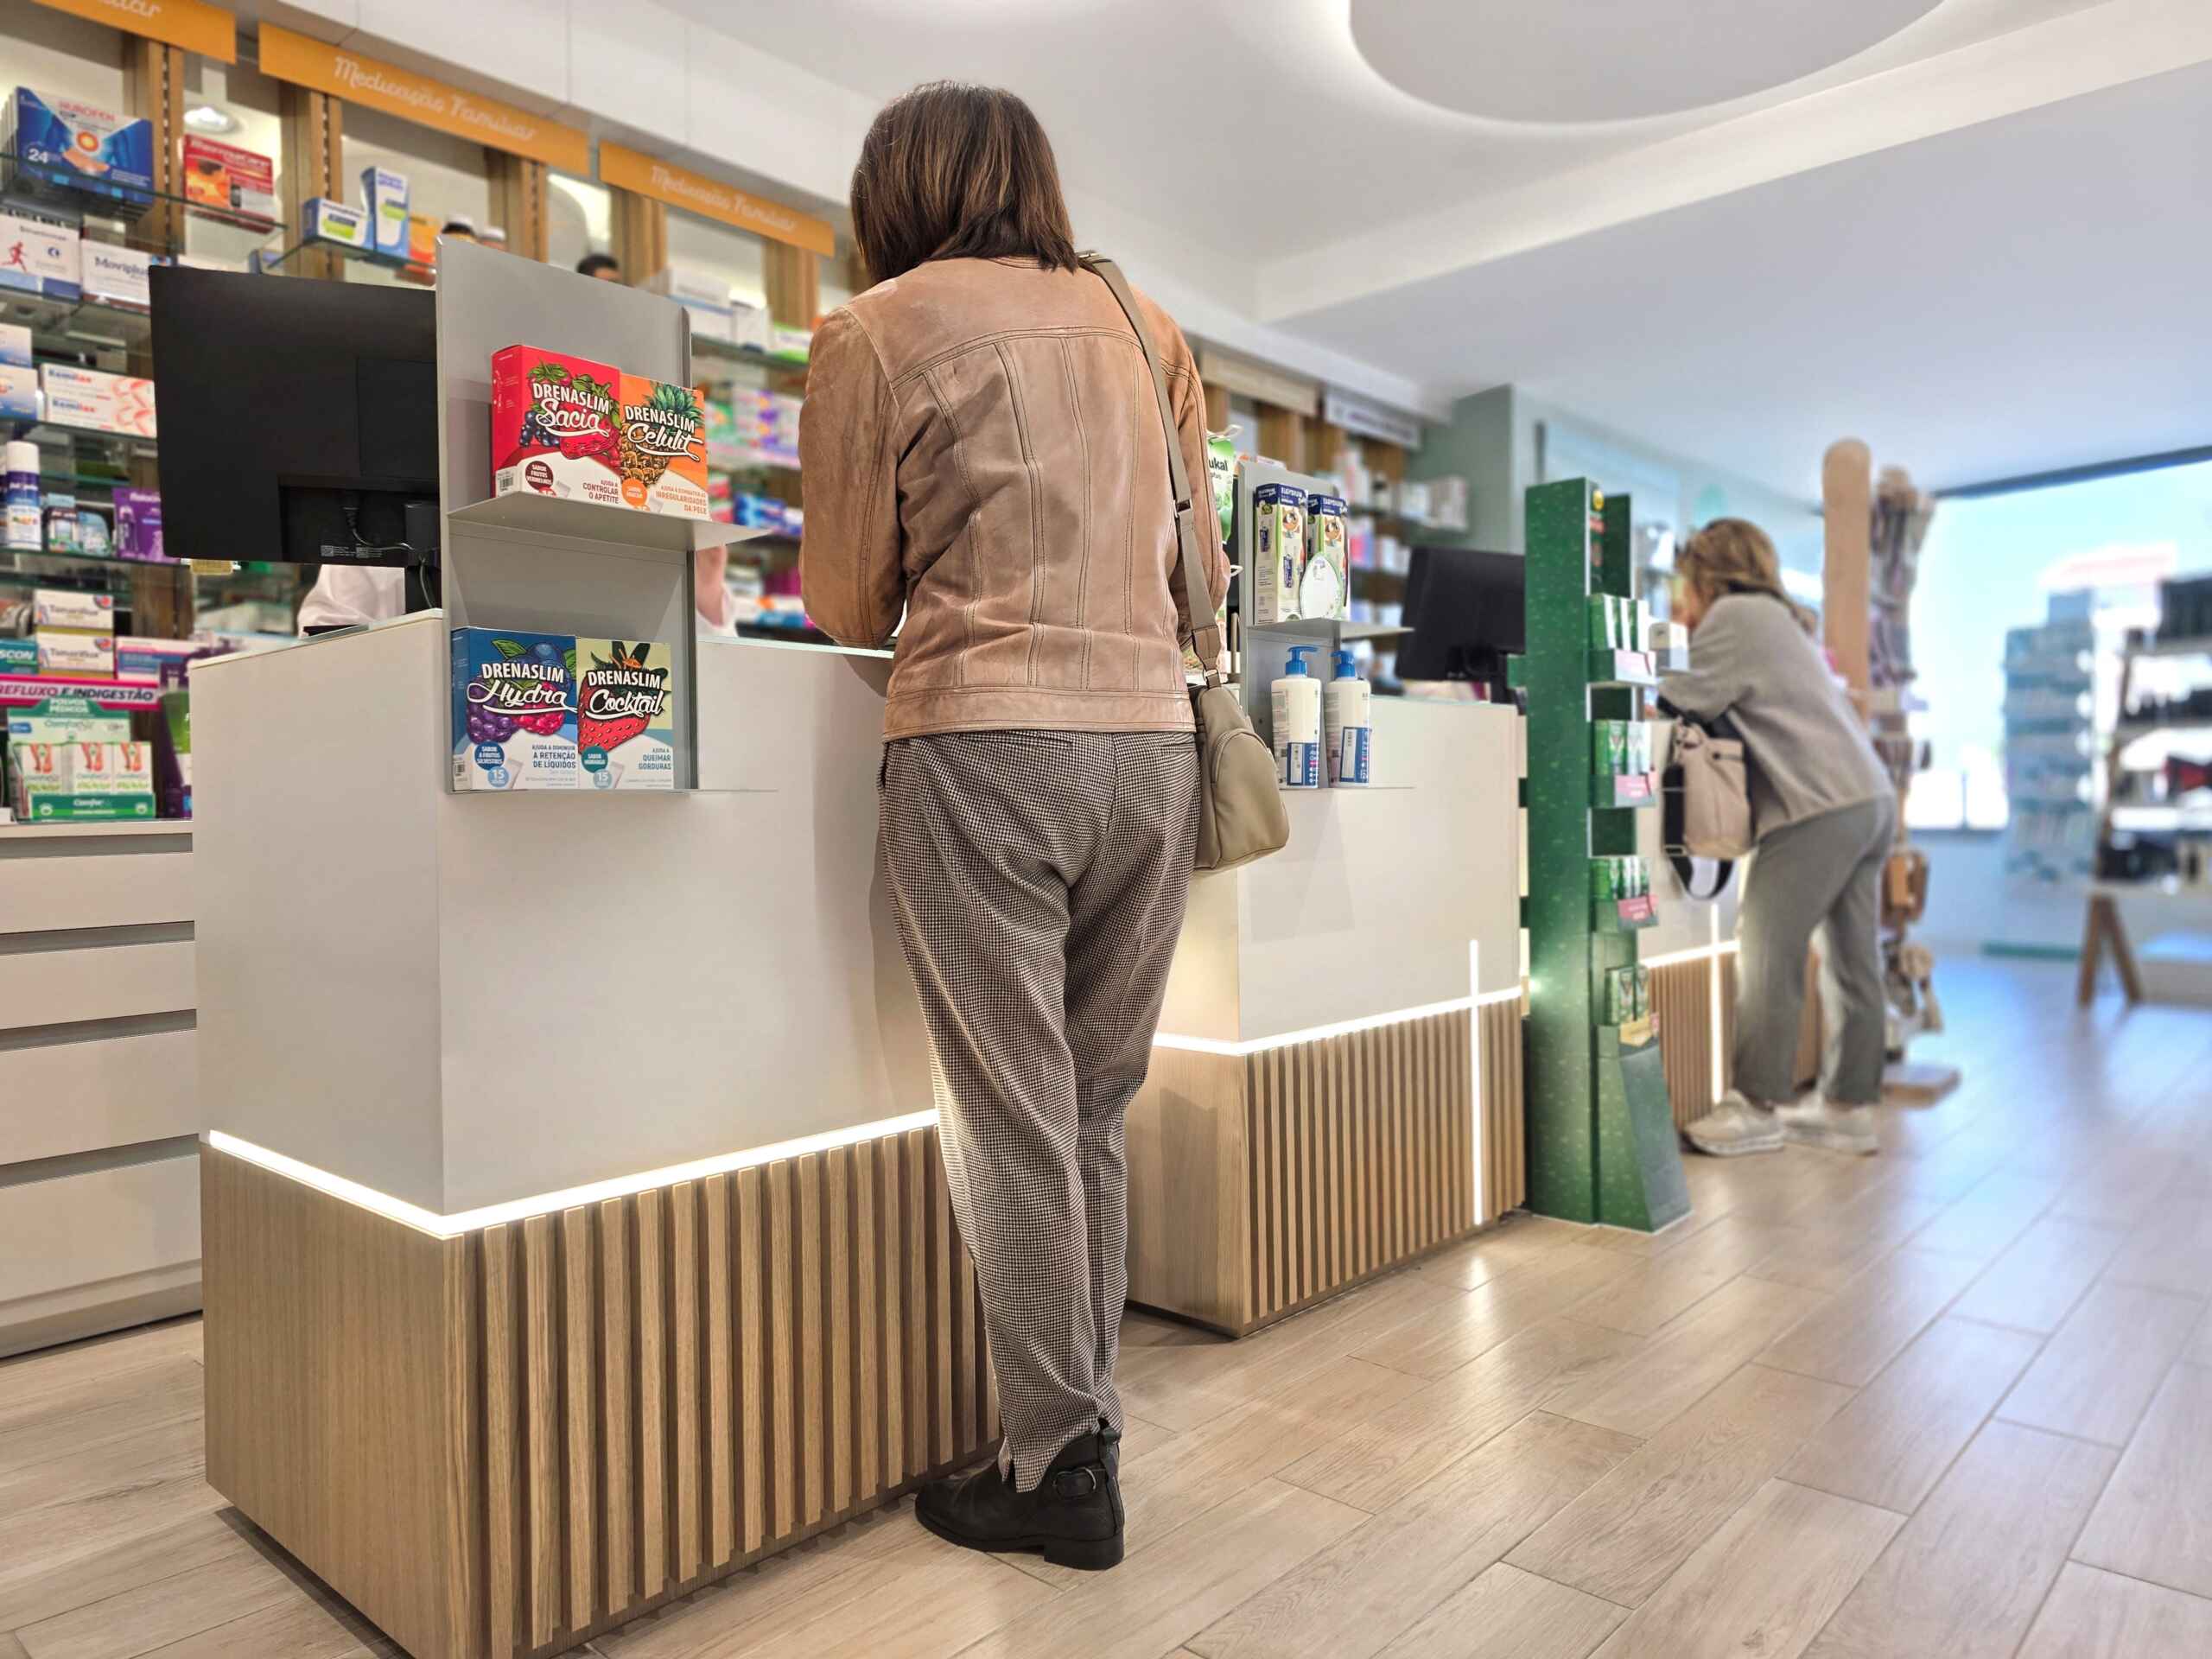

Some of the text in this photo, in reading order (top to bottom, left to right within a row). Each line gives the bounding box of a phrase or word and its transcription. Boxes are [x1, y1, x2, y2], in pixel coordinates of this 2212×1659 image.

[28, 148, 49, 163] 24
[532, 383, 611, 415] DRENASLIM
[536, 397, 610, 437] Sacia
[625, 405, 696, 432] DRENASLIM
[627, 423, 703, 461] Celulit
[1208, 457, 1228, 471] ukal
[582, 482, 619, 494] CONTROLAR
[594, 493, 620, 504] APETITE
[693, 505, 707, 514] PELE
[481, 663, 564, 683] DRENASLIM
[588, 671, 661, 690] DRENASLIM
[71, 687, 154, 701] INDIGESTÃO
[467, 680, 578, 715] Hydra
[586, 689, 664, 719] Cocktail
[539, 751, 575, 760] RETENÇÃO
[543, 760, 576, 769] LÍQUIDOS
[493, 769, 505, 779] 15
[598, 772, 609, 781] 15
